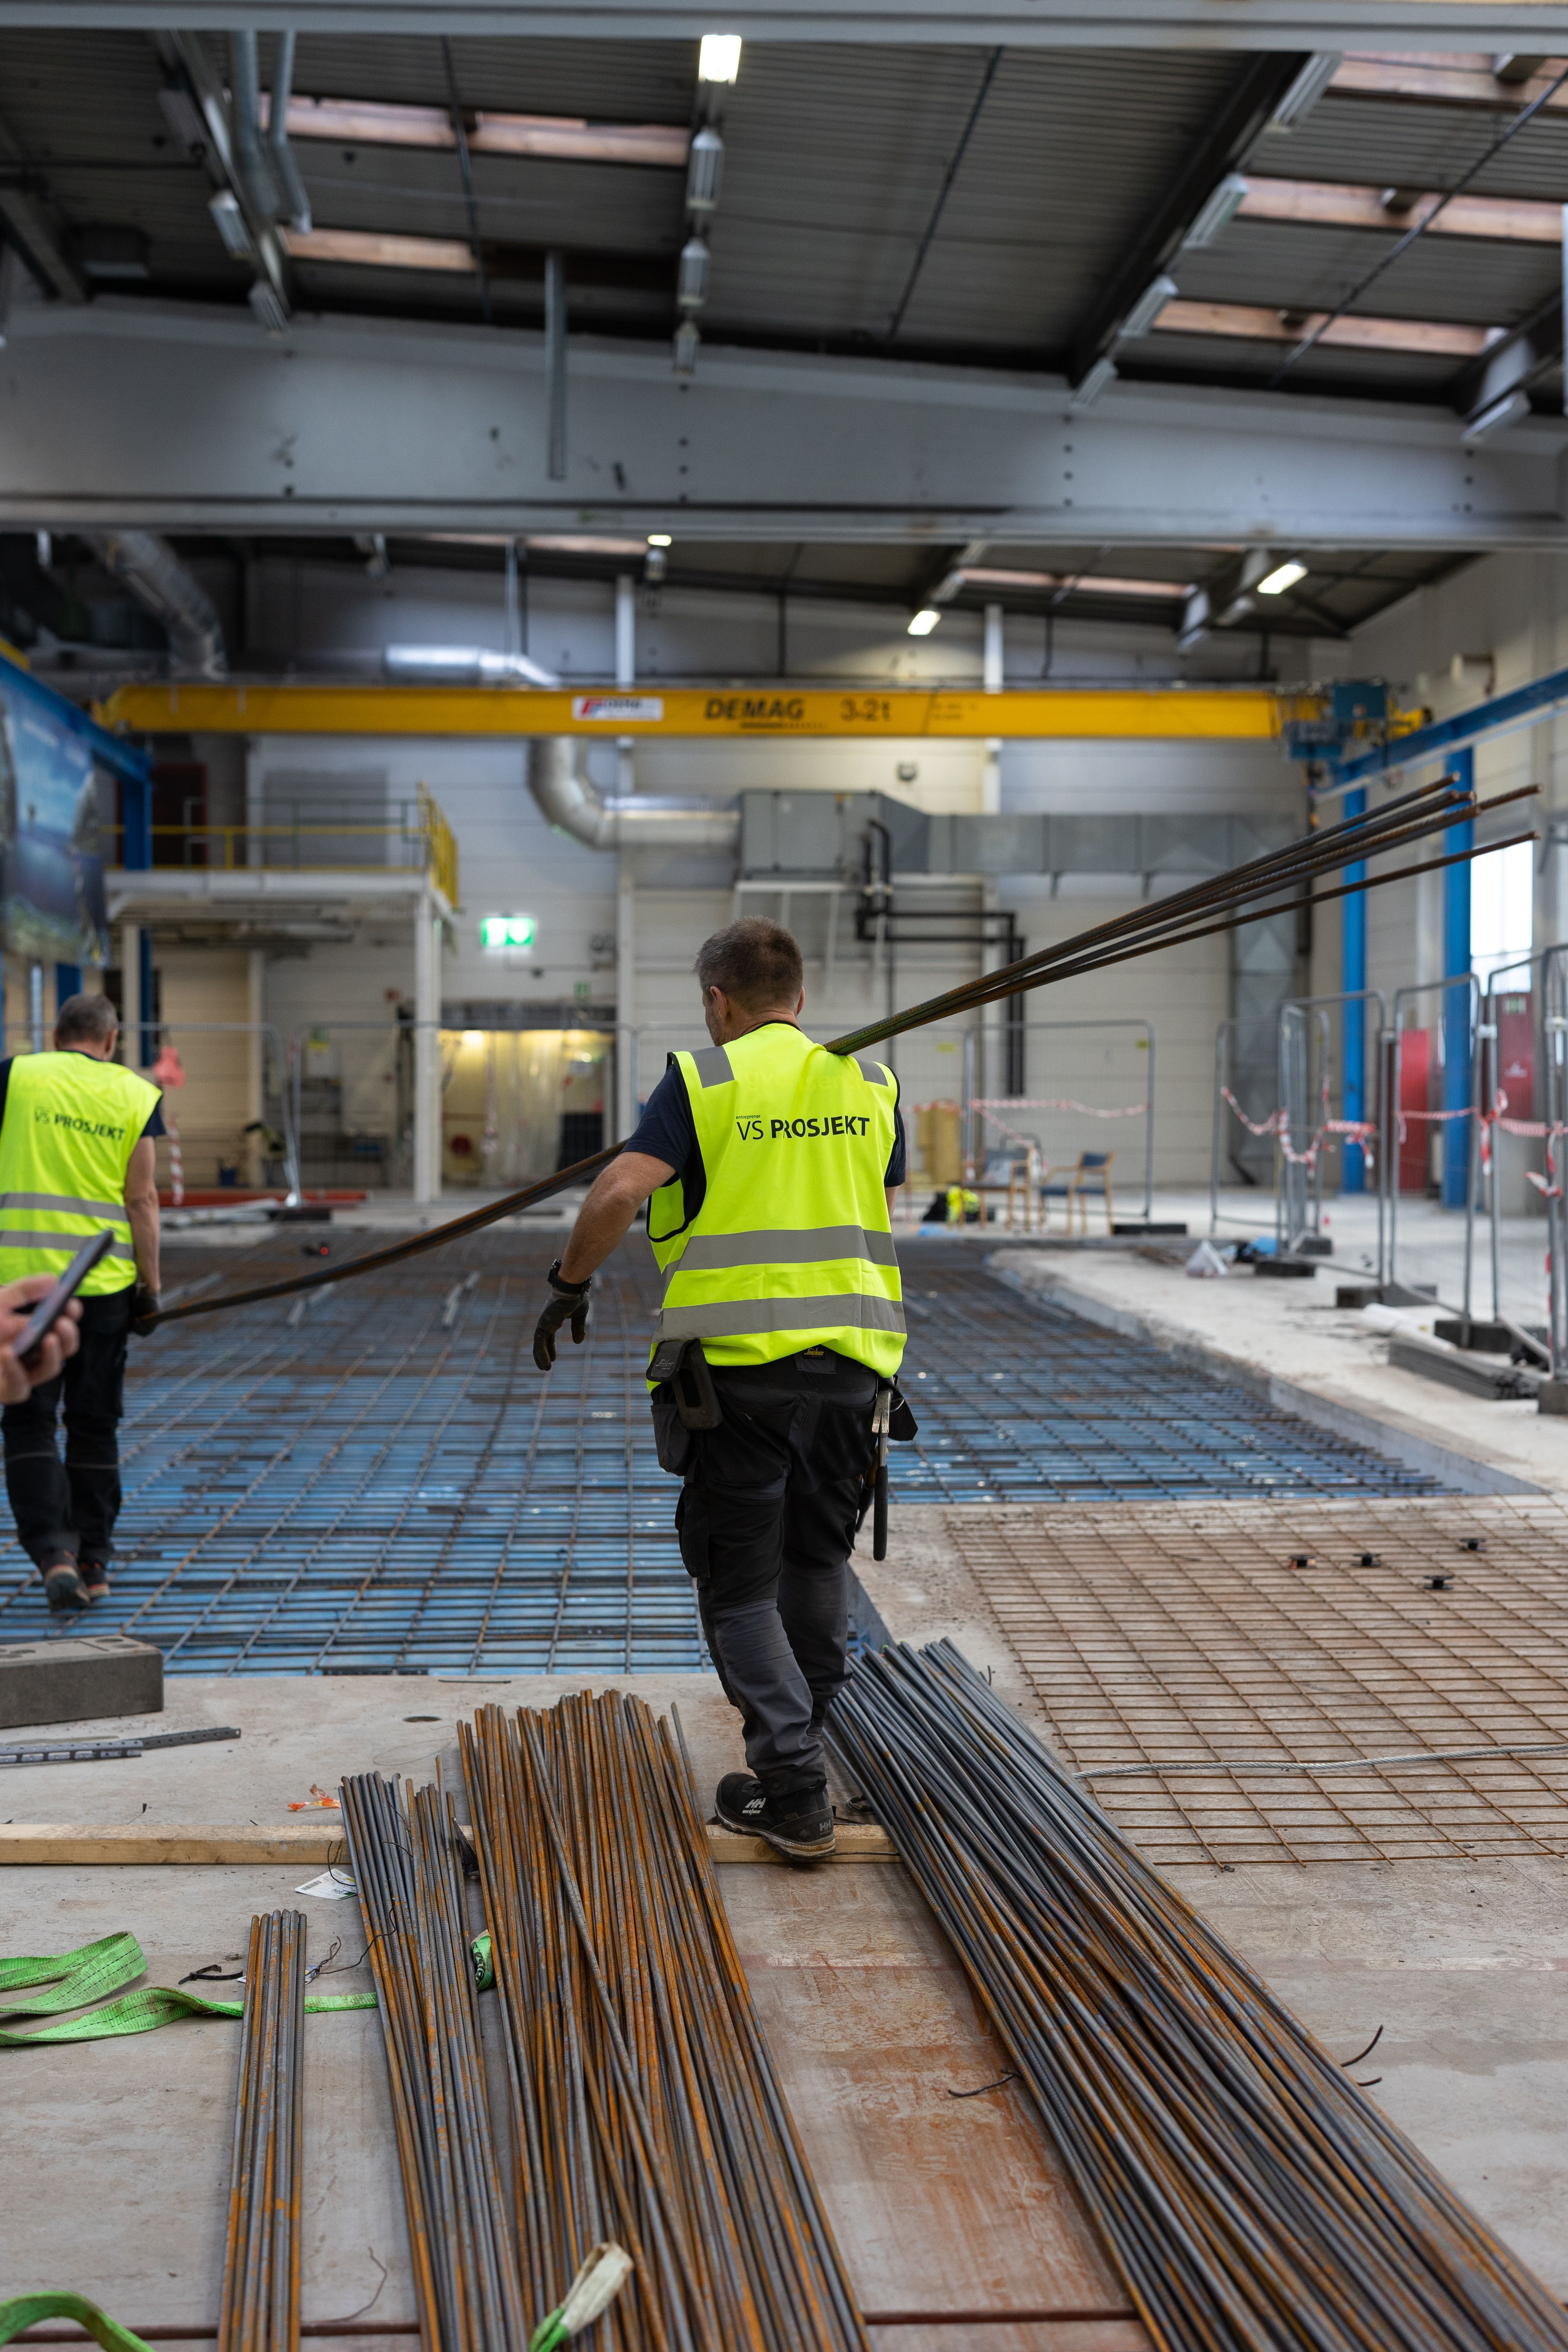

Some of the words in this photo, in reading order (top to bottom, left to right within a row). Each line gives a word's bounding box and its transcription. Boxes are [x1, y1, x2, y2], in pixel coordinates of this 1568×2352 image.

[705, 698, 805, 720] DEMAG
[54, 1114, 125, 1140] PROSJEKT
[736, 1121, 764, 1140] VS
[770, 1115, 870, 1139] PROSJEKT
[745, 1798, 766, 1808] HH
[819, 1820, 831, 1832] HH
